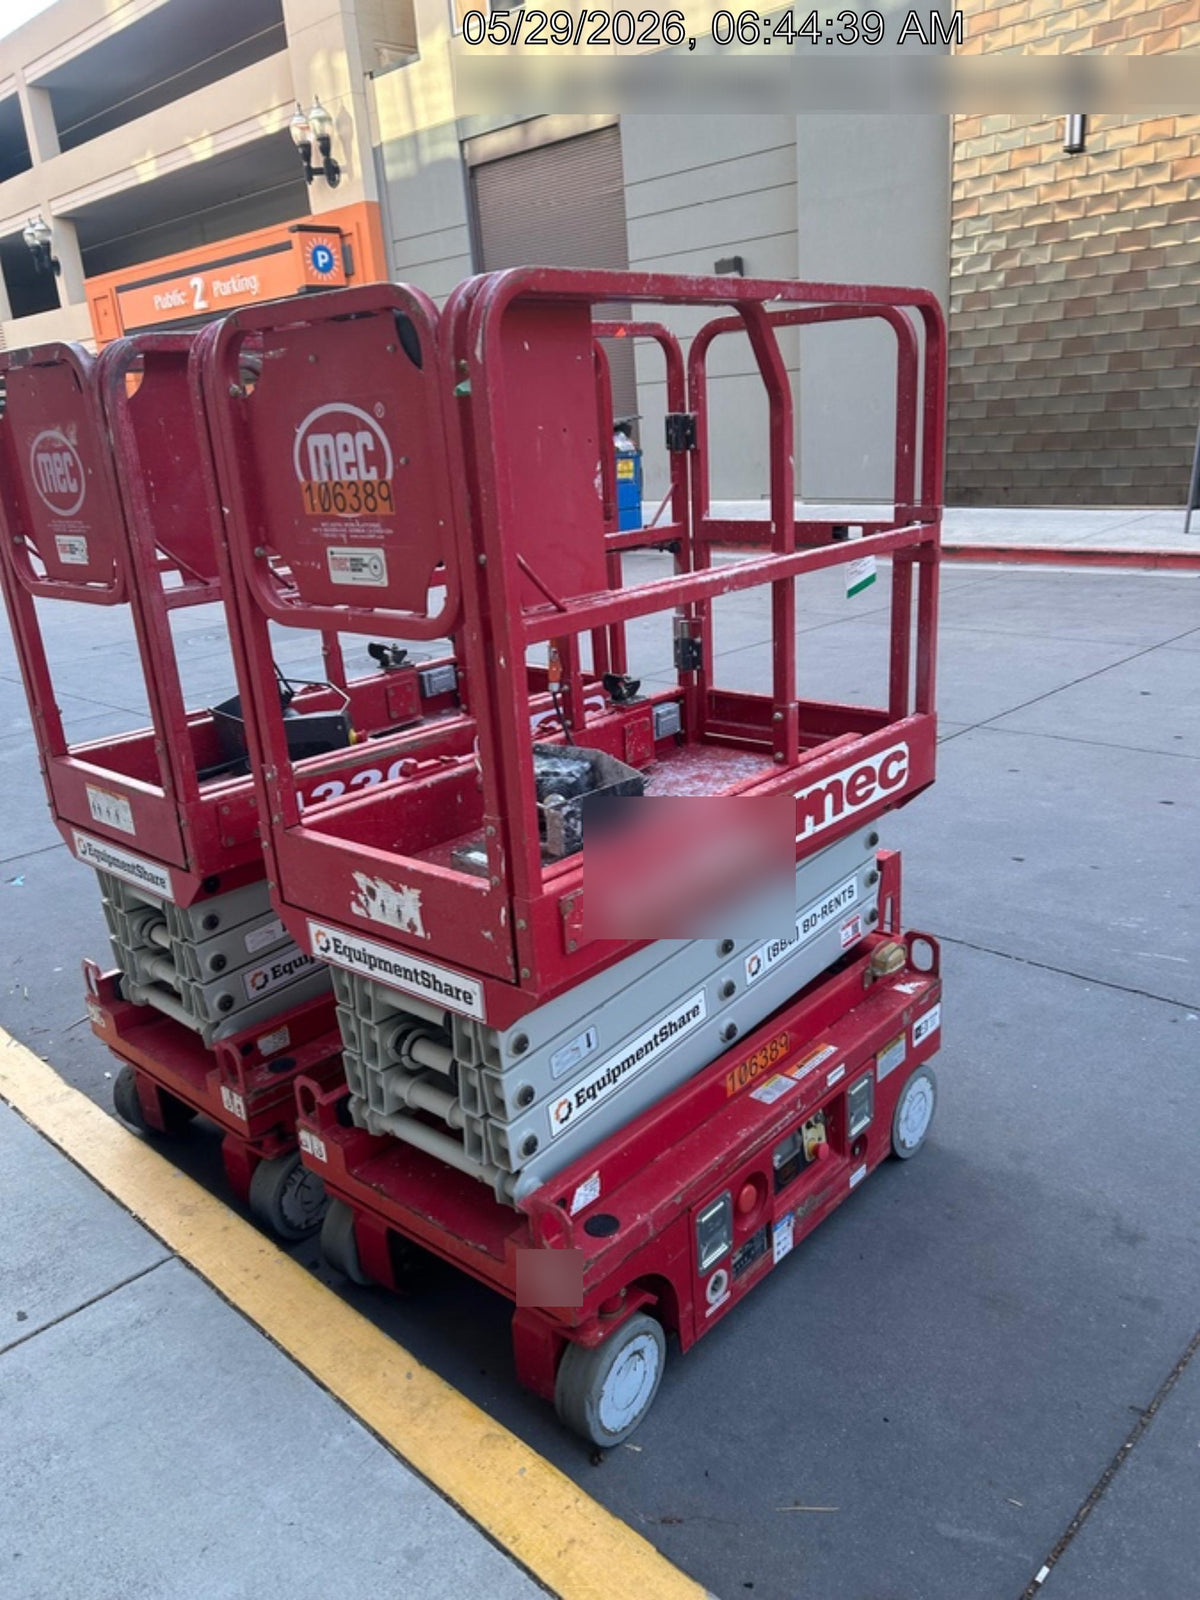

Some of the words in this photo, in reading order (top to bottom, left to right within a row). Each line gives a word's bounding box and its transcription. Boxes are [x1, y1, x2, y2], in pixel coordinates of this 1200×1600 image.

[317, 250, 329, 268] P
[153, 289, 187, 310] Public
[190, 276, 208, 309] 2
[211, 273, 259, 297] Parking
[307, 431, 377, 481] mec
[305, 480, 393, 513] 106389
[86, 842, 167, 889] EquipmentShare
[332, 936, 474, 1005] EquipmentShare
[573, 1004, 701, 1108] EquipmentShare
[728, 1031, 789, 1092] 106389
